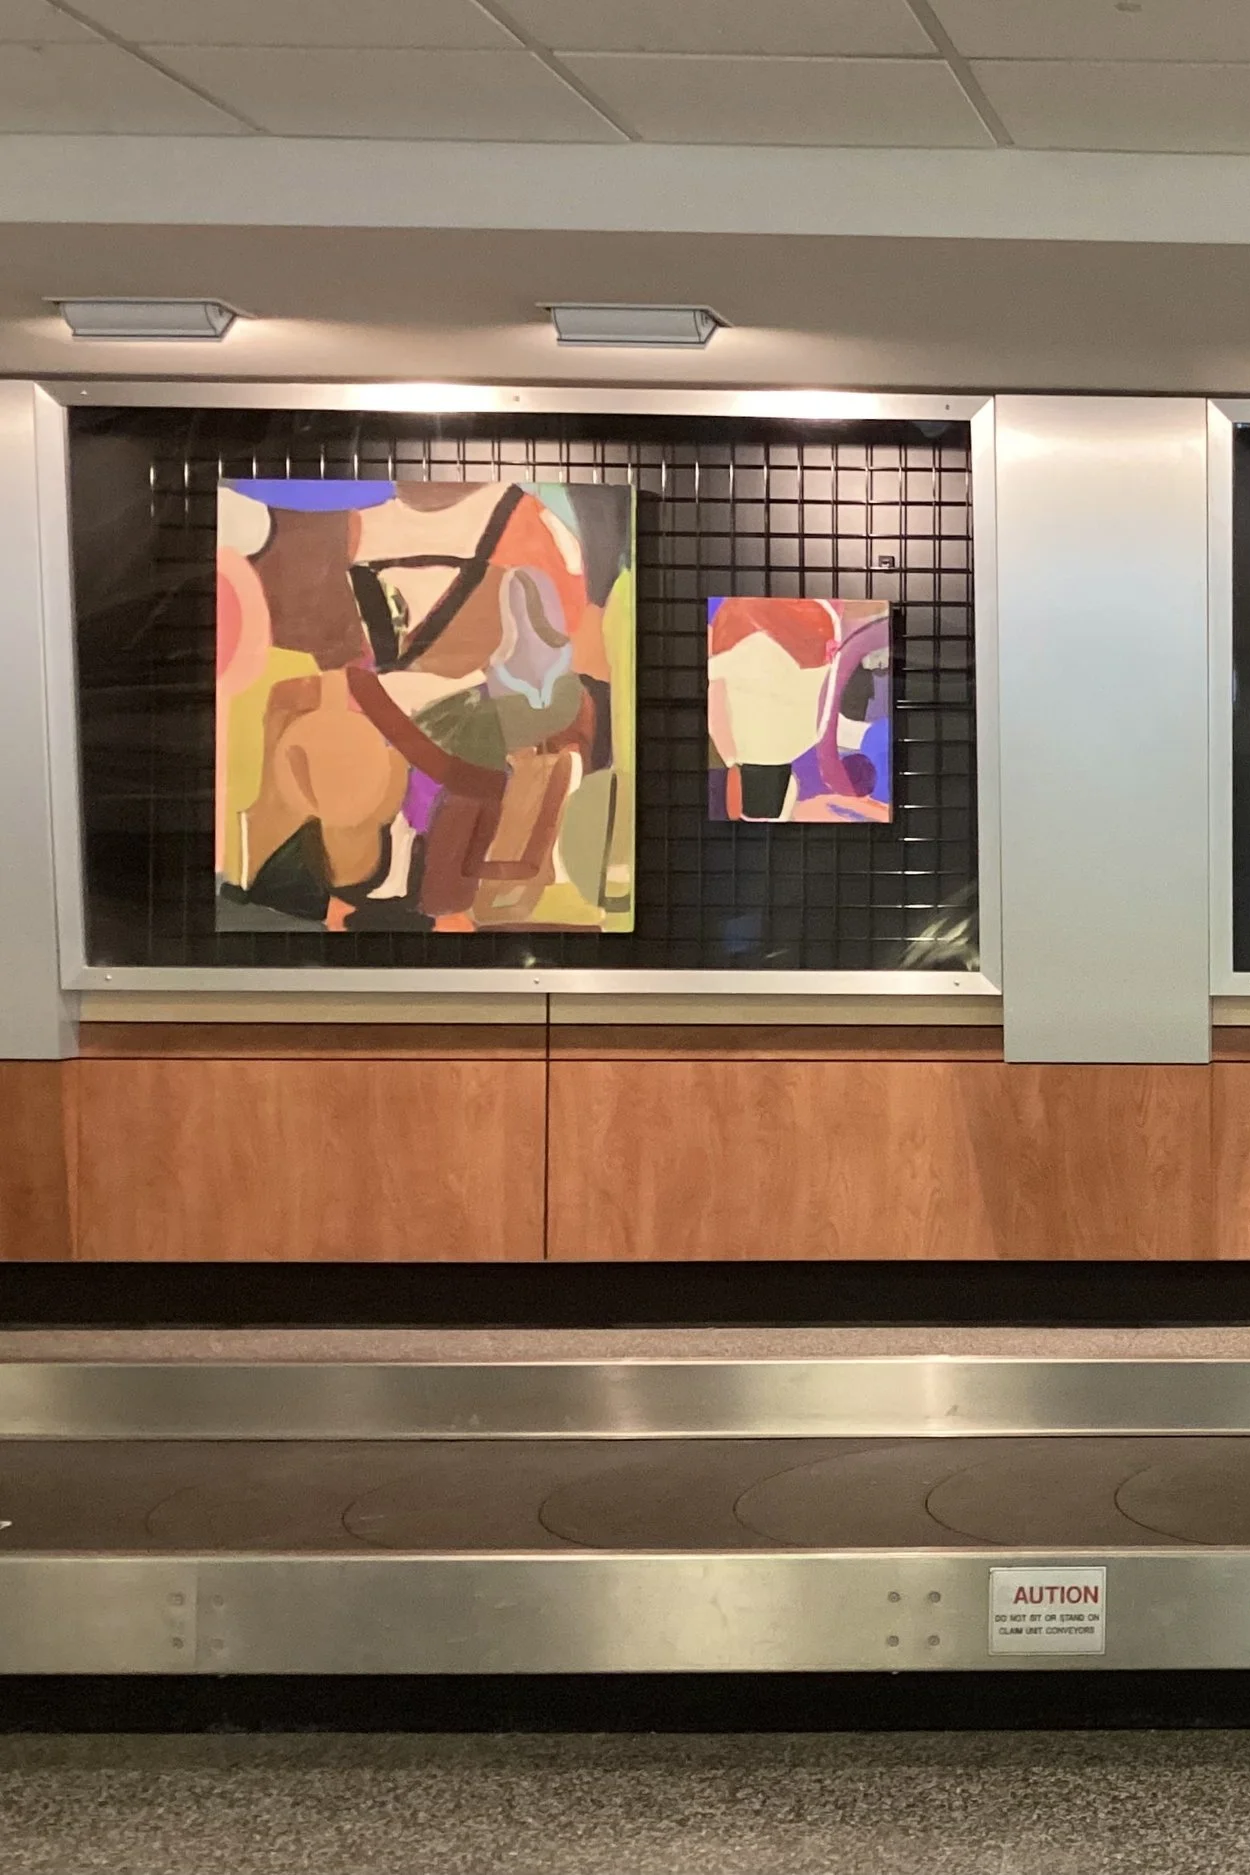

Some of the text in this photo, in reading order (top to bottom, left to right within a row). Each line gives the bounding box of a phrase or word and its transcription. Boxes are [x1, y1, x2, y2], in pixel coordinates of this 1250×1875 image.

[1010, 1614, 1026, 1622] NOT
[1045, 1614, 1056, 1622] OR
[1060, 1614, 1085, 1622] STAND
[1046, 1626, 1095, 1634] CONVEYORS
